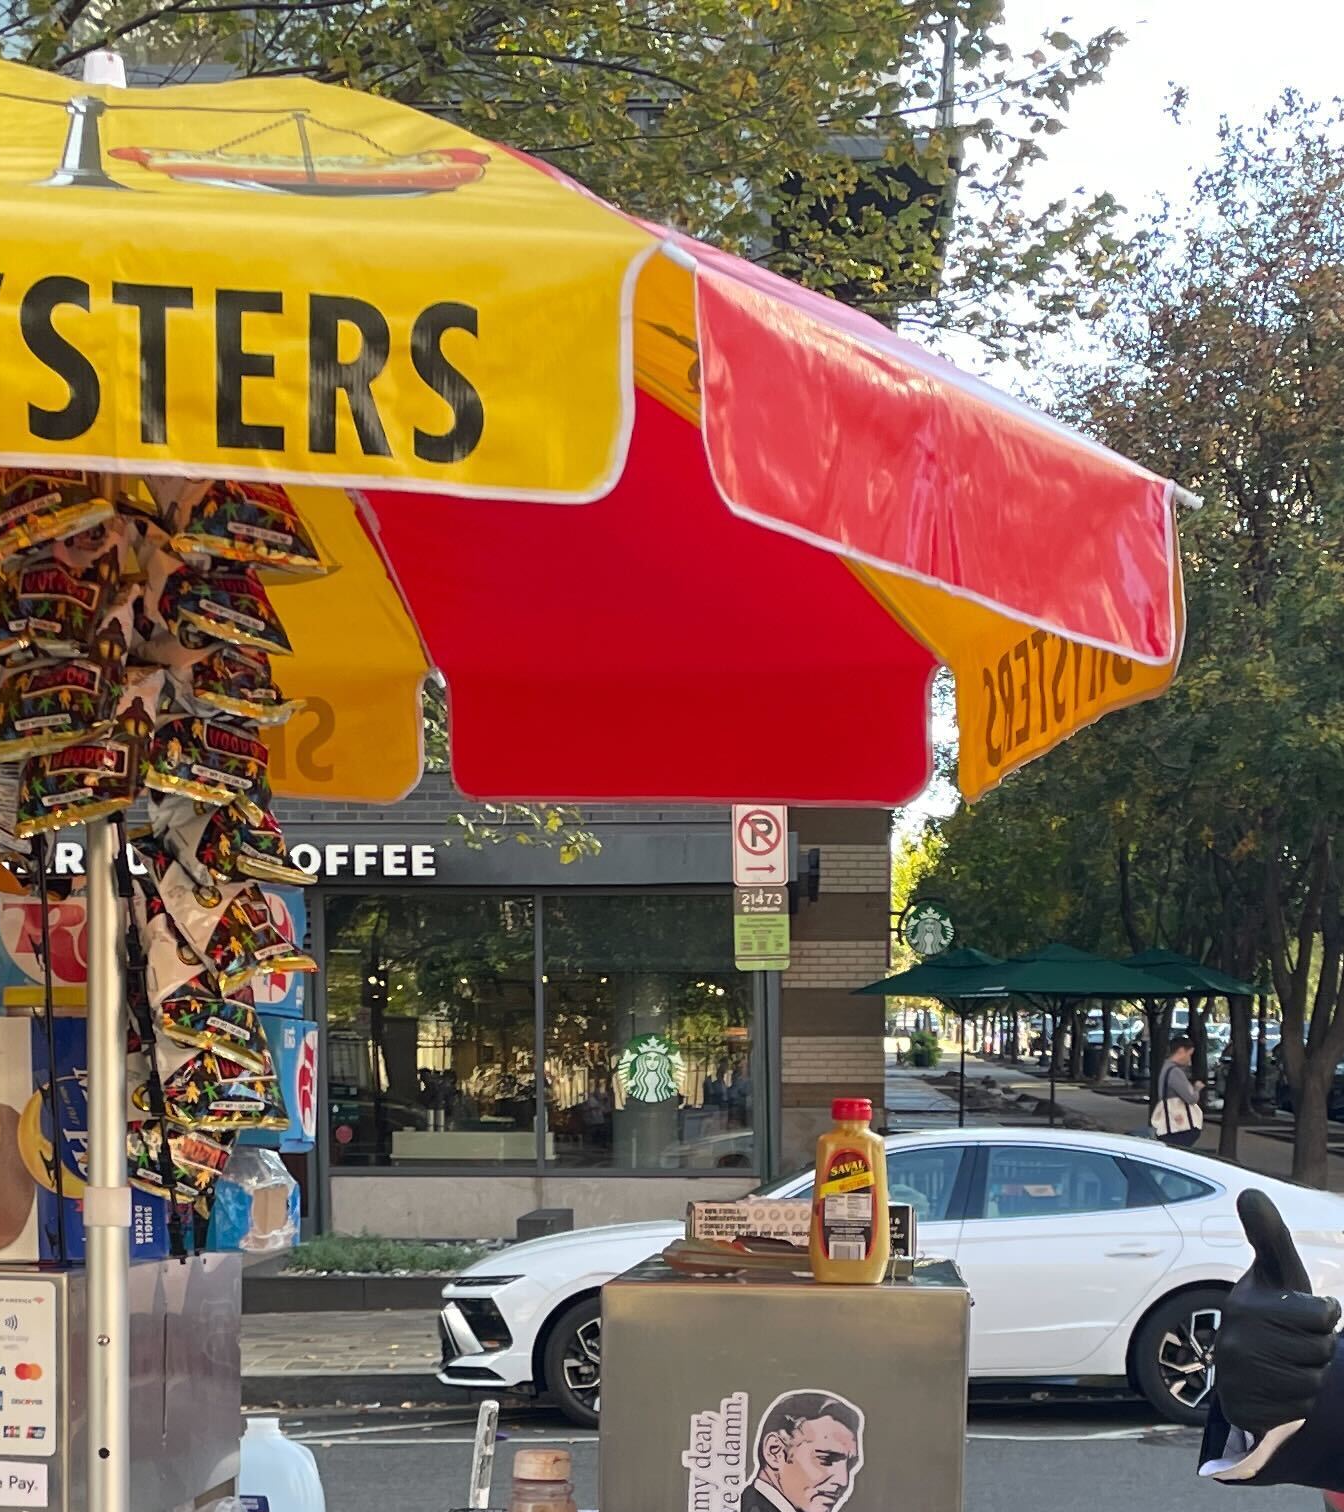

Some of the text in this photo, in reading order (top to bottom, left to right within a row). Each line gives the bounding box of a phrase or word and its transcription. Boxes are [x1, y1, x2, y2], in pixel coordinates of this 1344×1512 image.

[289, 843, 436, 877] OFFEE
[741, 893, 783, 905] 21473
[830, 1159, 866, 1177] SAVAL
[134, 1205, 144, 1245] DECKER
[143, 1206, 153, 1243] SINGLE
[687, 1416, 717, 1469] dear,
[717, 1396, 743, 1466] damn.
[8, 1475, 39, 1494] Pay.
[694, 1476, 719, 1512] my
[724, 1474, 740, 1486] a
